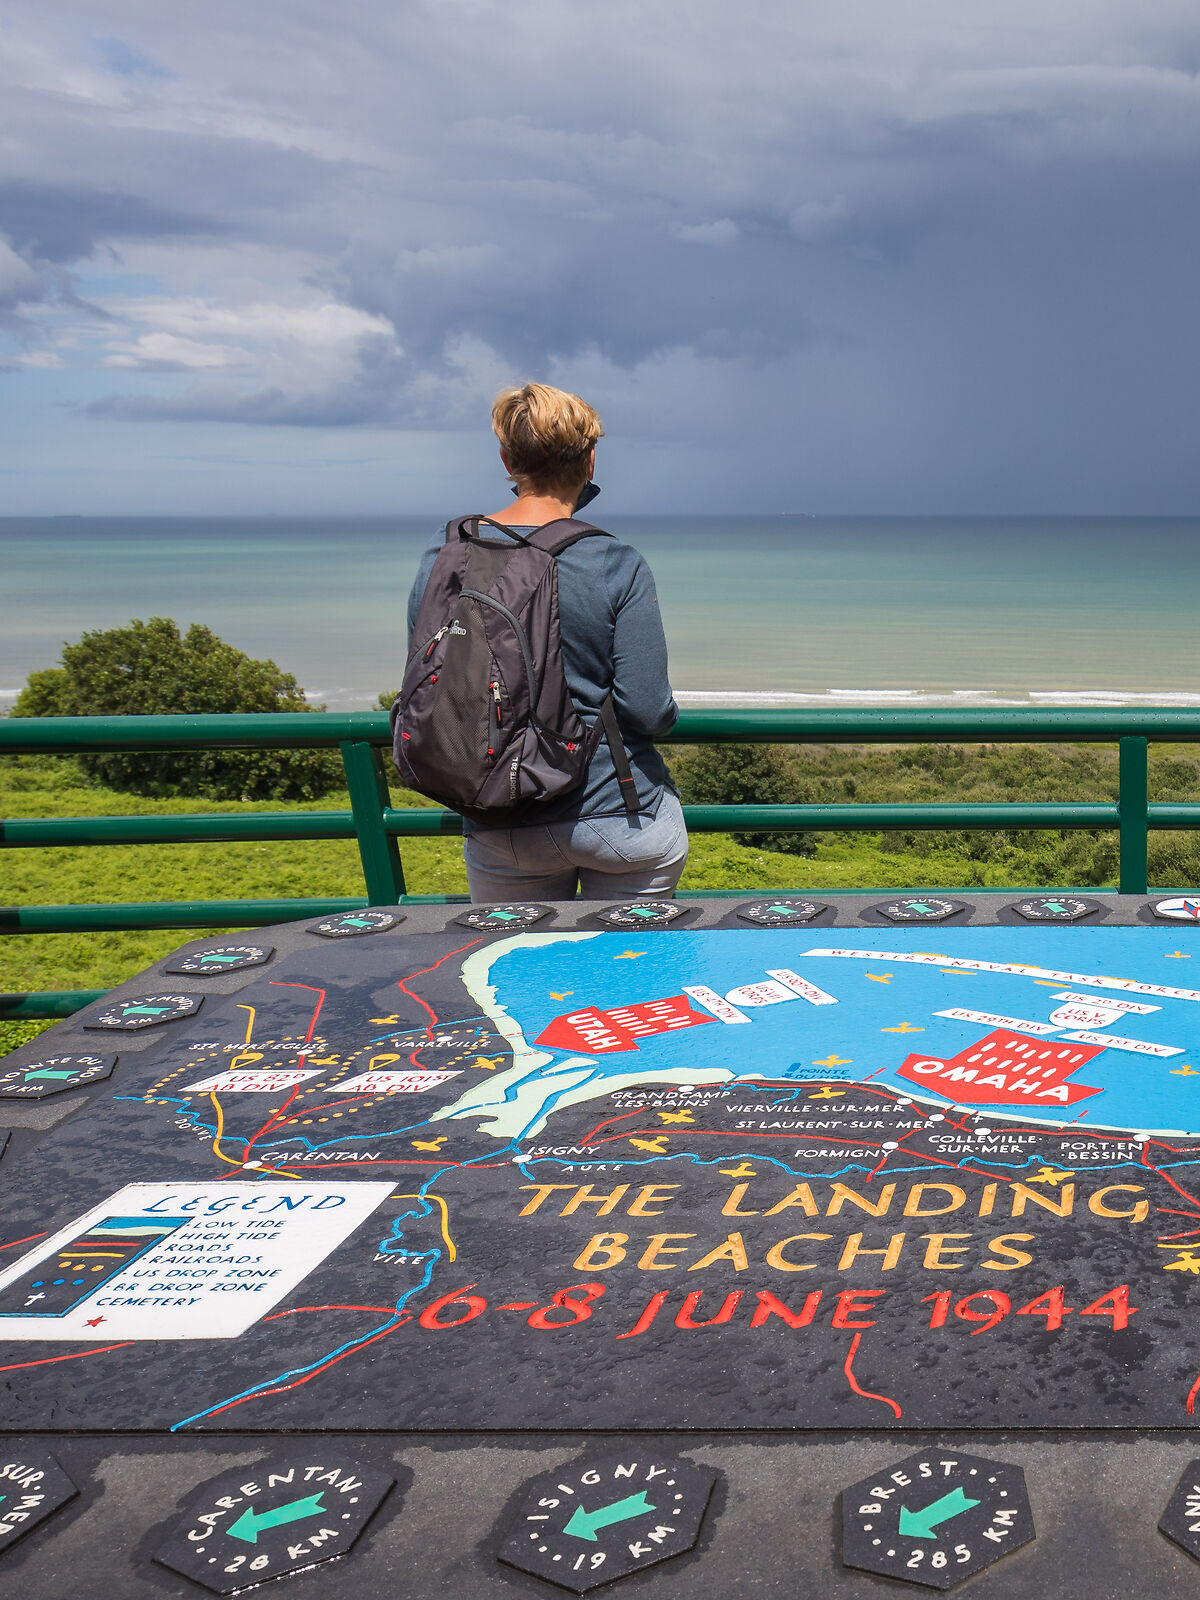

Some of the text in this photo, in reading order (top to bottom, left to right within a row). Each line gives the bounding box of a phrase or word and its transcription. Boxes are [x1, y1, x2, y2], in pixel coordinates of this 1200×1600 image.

[830, 950, 936, 962] WESTERN
[952, 960, 1027, 974] NAVAL
[1051, 972, 1104, 986] TASK
[566, 1011, 623, 1051] UTAH
[394, 1040, 492, 1048] VARREVILLE
[229, 1075, 257, 1083] US
[367, 1075, 392, 1083] US
[912, 1060, 1070, 1102] OMAHA
[389, 1084, 430, 1092] DIV
[735, 1121, 757, 1129] ST
[527, 1146, 601, 1155] ISIGNY
[795, 1149, 895, 1158] FORMIGNY
[260, 1152, 381, 1161] CARENTAN
[561, 1164, 623, 1172] AURE
[142, 1194, 347, 1216] LEGEND
[518, 1182, 1150, 1224] THE LANDING
[194, 1219, 288, 1230] LOW TIDE
[179, 1231, 282, 1241] HIGH TIDE
[167, 1243, 235, 1253] ROADS
[572, 1231, 1036, 1272] BEACHES
[149, 1255, 263, 1265] RAILROADS
[372, 1252, 427, 1265] VIRE
[133, 1268, 283, 1279] US DROP ZONE
[148, 1282, 205, 1292] DROP
[209, 1282, 268, 1292] ZONE
[96, 1296, 201, 1307] CEMETERY
[418, 1282, 1140, 1340] 6-8 JUNE 1944
[526, 1462, 667, 1520] ISIGNY
[858, 1461, 958, 1515] BREST
[188, 1466, 362, 1541] CARENTAN
[907, 1508, 1019, 1569] 285 KM
[224, 1527, 339, 1573] 28 KM
[573, 1524, 677, 1570] 19 KM
